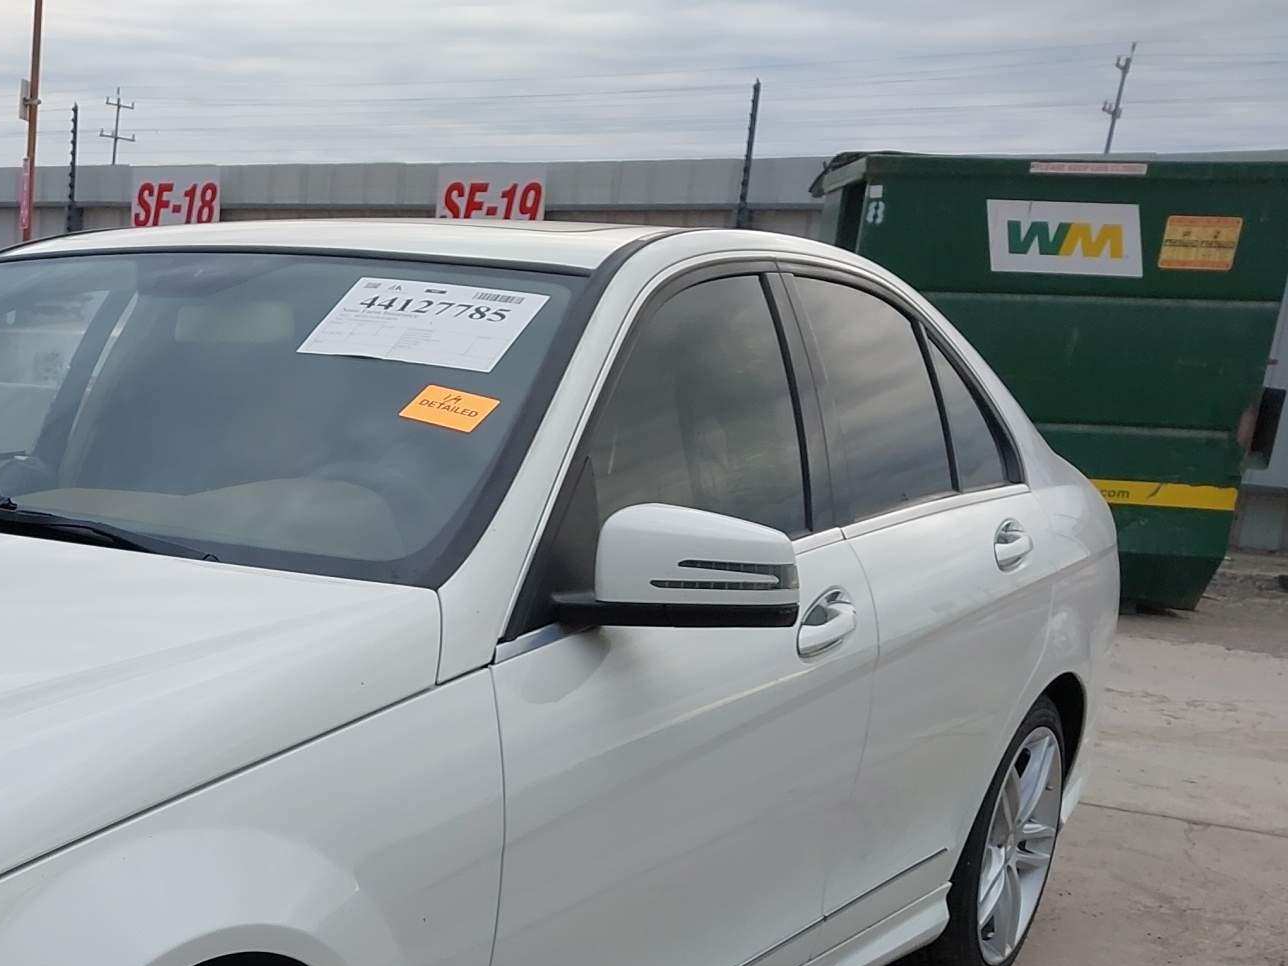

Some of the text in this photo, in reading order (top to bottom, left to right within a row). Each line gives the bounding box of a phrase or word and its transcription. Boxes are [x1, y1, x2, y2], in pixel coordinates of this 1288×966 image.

[134, 182, 217, 227] SF-18
[444, 182, 542, 221] SF-19
[1007, 220, 1124, 259] WM
[359, 295, 512, 323] 44127785
[418, 399, 479, 418] DETAILED
